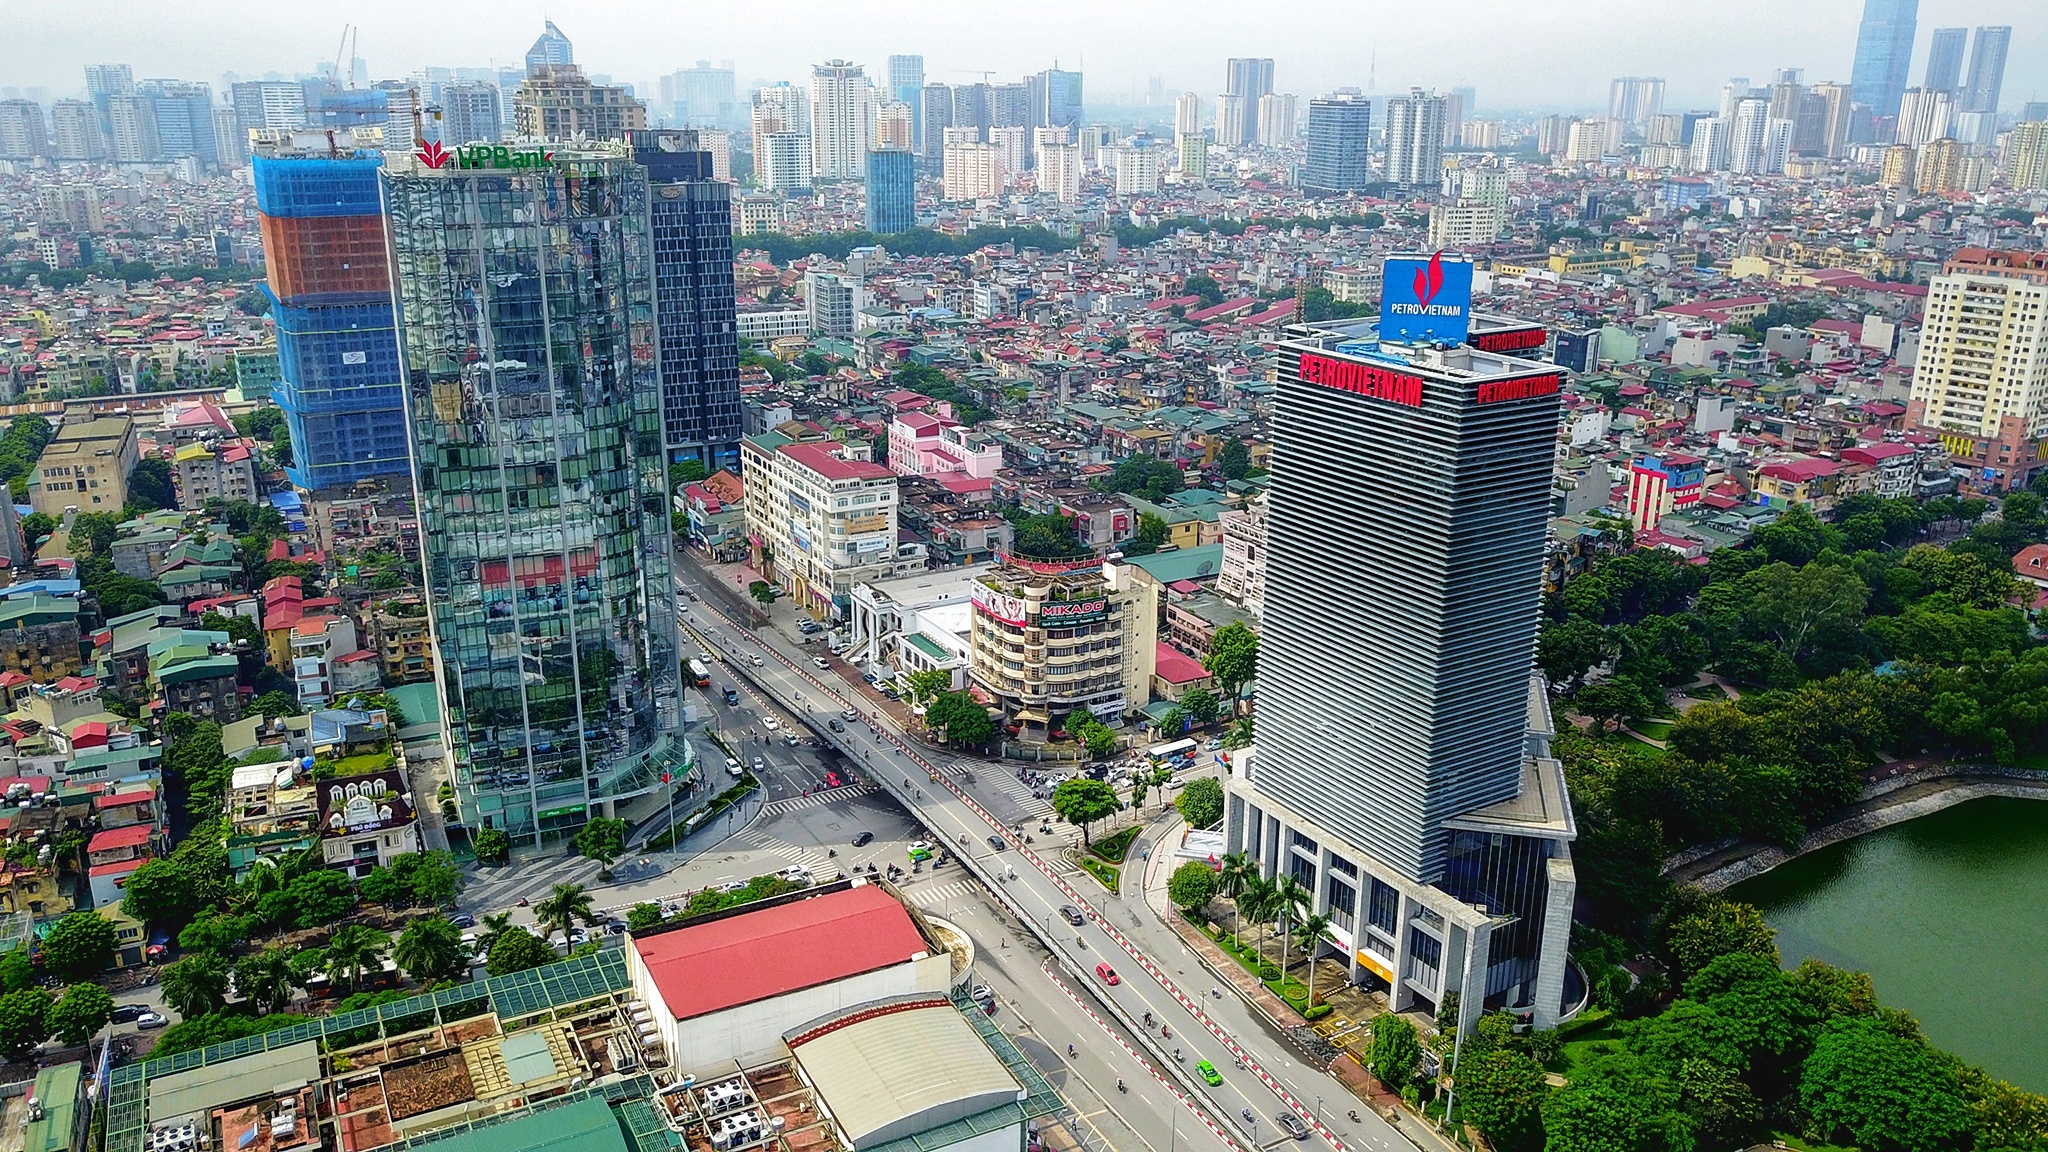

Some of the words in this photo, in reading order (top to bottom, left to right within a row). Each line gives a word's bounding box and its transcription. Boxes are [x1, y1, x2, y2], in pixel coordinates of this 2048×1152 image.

[456, 146, 554, 169] VPBank
[1391, 303, 1461, 316] PETROVIETNAM
[1478, 330, 1546, 352] PETROVIETNAM
[1299, 352, 1423, 407] PETROVIETNAM
[1477, 374, 1559, 404] PETROVIETNAM
[1042, 601, 1104, 617] MIKADO
